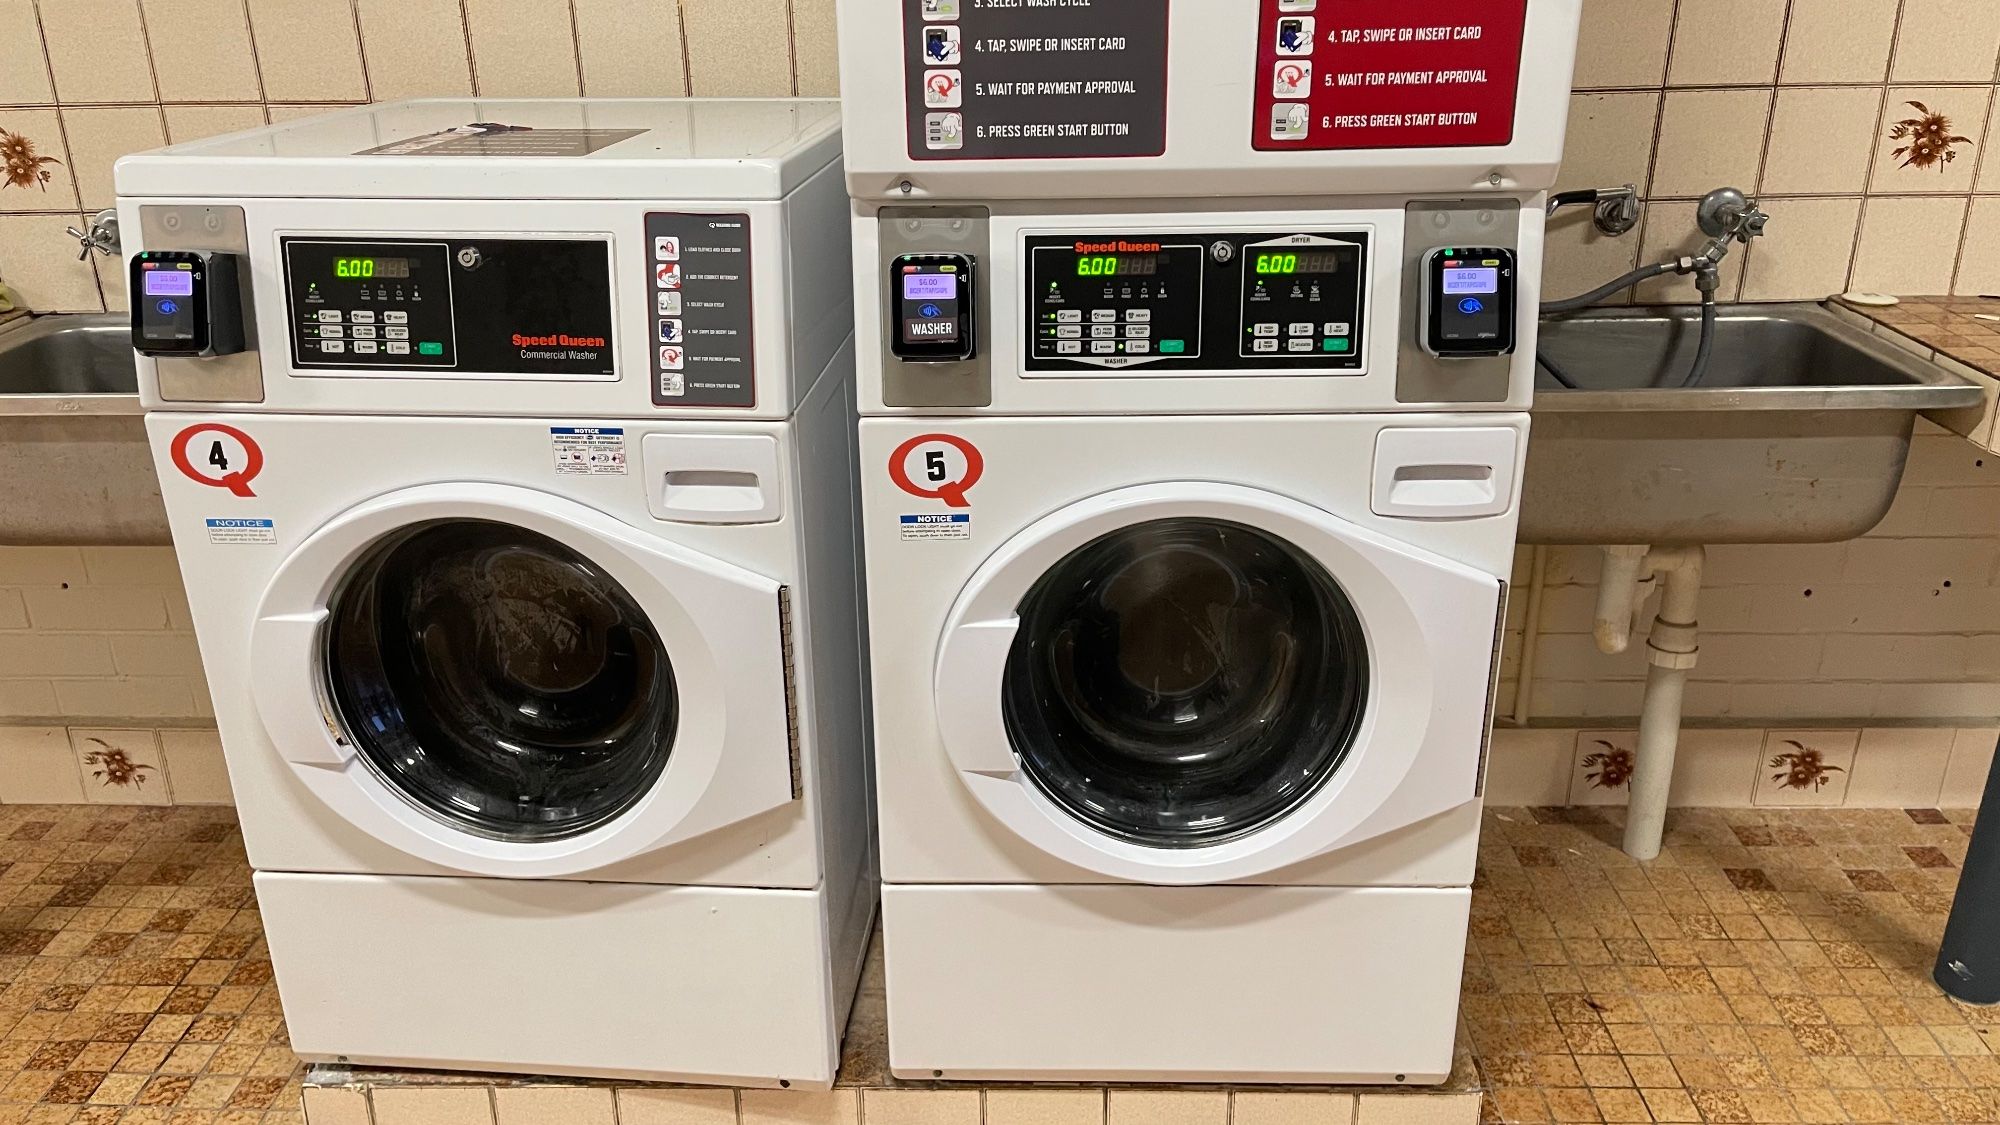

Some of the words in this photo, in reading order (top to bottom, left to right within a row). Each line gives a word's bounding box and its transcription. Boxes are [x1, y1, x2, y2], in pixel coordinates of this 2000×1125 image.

[1328, 31, 1337, 43] 4.
[1341, 30, 1360, 44] TAP,
[1363, 29, 1396, 42] SWIPE
[1398, 28, 1412, 41] OR
[1415, 27, 1451, 41] INSERT
[1453, 26, 1481, 40] CARD
[975, 40, 984, 52] 4.
[987, 39, 1007, 53] TAP,
[1010, 39, 1041, 52] SWIPE
[1045, 38, 1058, 51] OR
[1061, 38, 1096, 51] INSERT
[1098, 37, 1125, 50] CARD
[1325, 75, 1334, 86] 5.
[1337, 73, 1363, 86] WAIT
[1366, 73, 1385, 85] FOR
[1388, 72, 1433, 85] PAYMENT
[1436, 70, 1487, 83] APPROVAL
[976, 83, 985, 96] 5.
[988, 83, 1013, 95] WAIT
[1016, 83, 1034, 95] FOR
[1038, 82, 1082, 95] PAYMENT
[1085, 81, 1136, 94] APPROVAL
[1323, 116, 1332, 128] 6.
[1335, 115, 1367, 127] PRESS
[1370, 114, 1401, 126] GREEN
[1404, 114, 1436, 126] START
[1438, 113, 1477, 125] BUTTON
[977, 125, 986, 138] 6.
[989, 125, 1021, 138] PRESS
[1024, 124, 1055, 137] GREEN
[1057, 124, 1088, 136] START
[1091, 123, 1128, 136] BUTTON
[1075, 242, 1116, 254] Speed
[1119, 241, 1160, 252] Queen
[338, 260, 373, 277] 6.00
[1078, 257, 1117, 275] 6.00
[1256, 255, 1296, 273] 6.00
[912, 323, 952, 335] WASHER
[512, 334, 557, 347] Speed
[559, 335, 605, 346] Queen
[520, 350, 566, 359] Commercial
[568, 351, 597, 360] Washer
[209, 441, 228, 470] 4
[926, 451, 945, 481] 5
